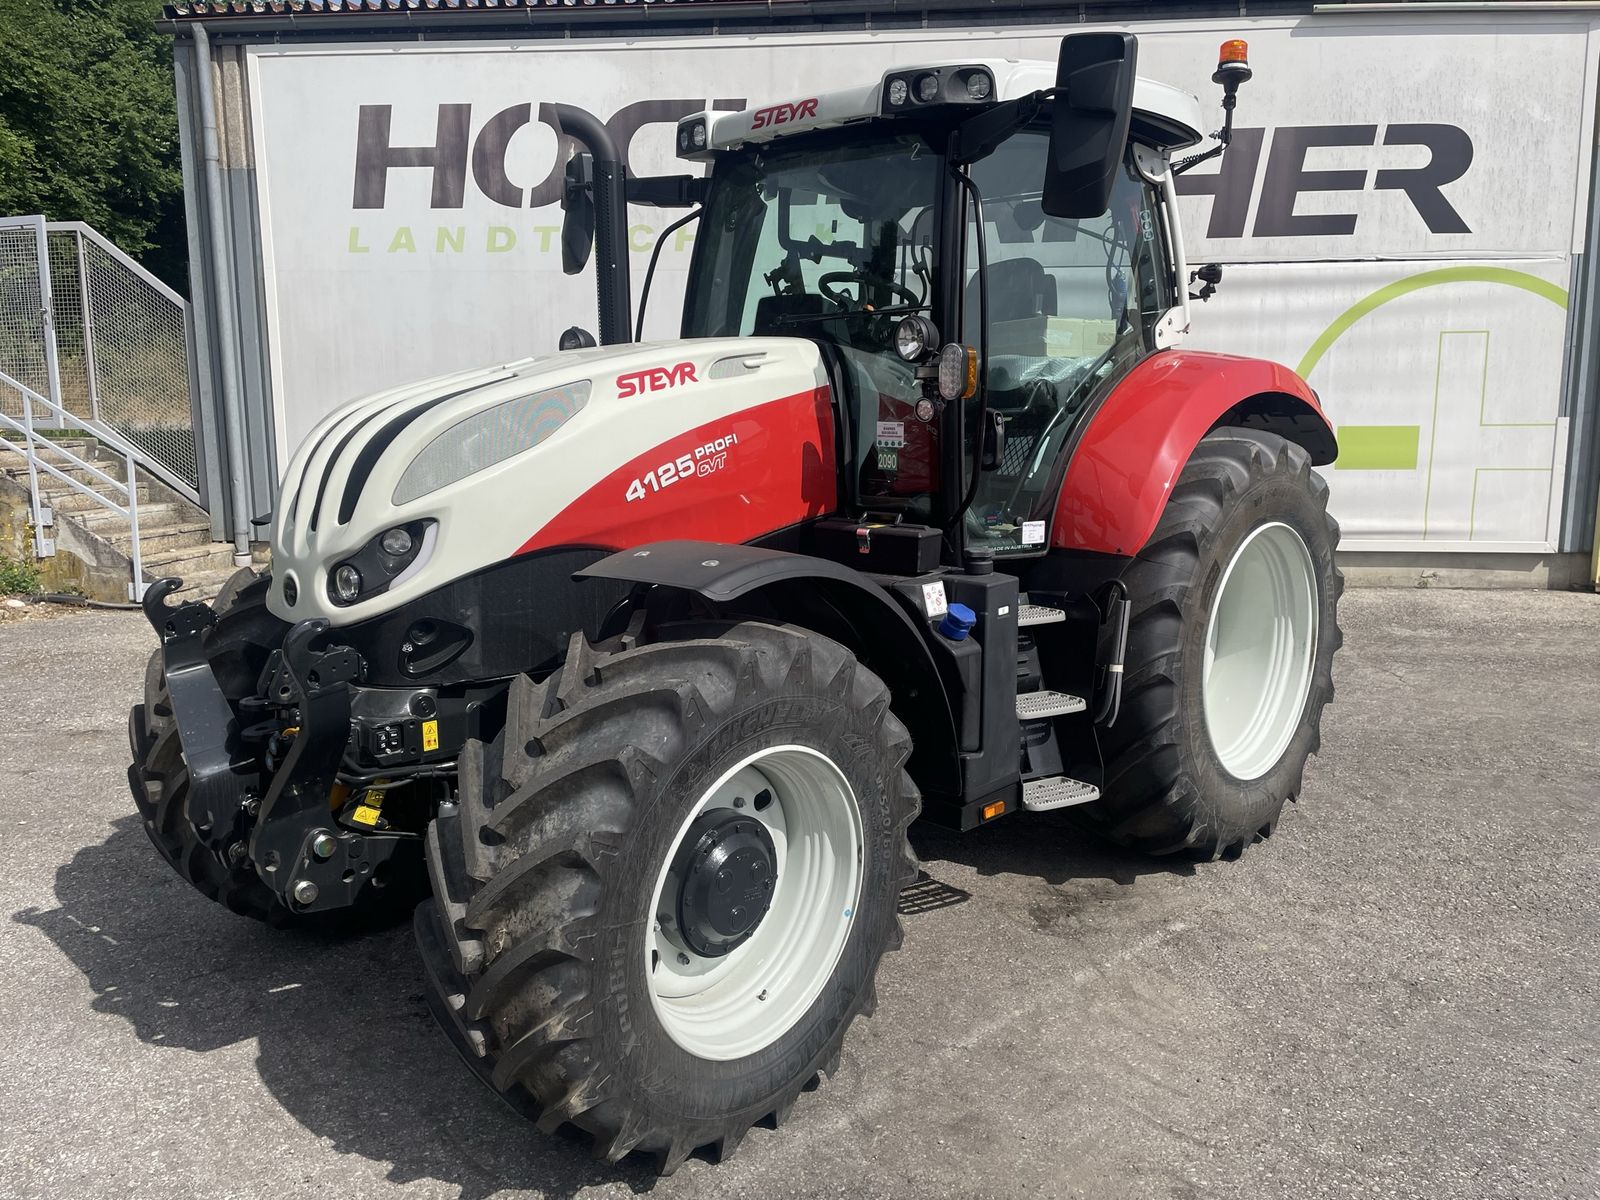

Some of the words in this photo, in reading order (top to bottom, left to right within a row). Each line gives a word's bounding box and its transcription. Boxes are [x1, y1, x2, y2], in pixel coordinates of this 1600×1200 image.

[750, 97, 819, 130] STEYR
[616, 362, 699, 399] STEYR
[625, 453, 697, 502] 4125
[694, 433, 738, 460] PROFI
[696, 452, 727, 478] CVT
[878, 453, 897, 469] 2090
